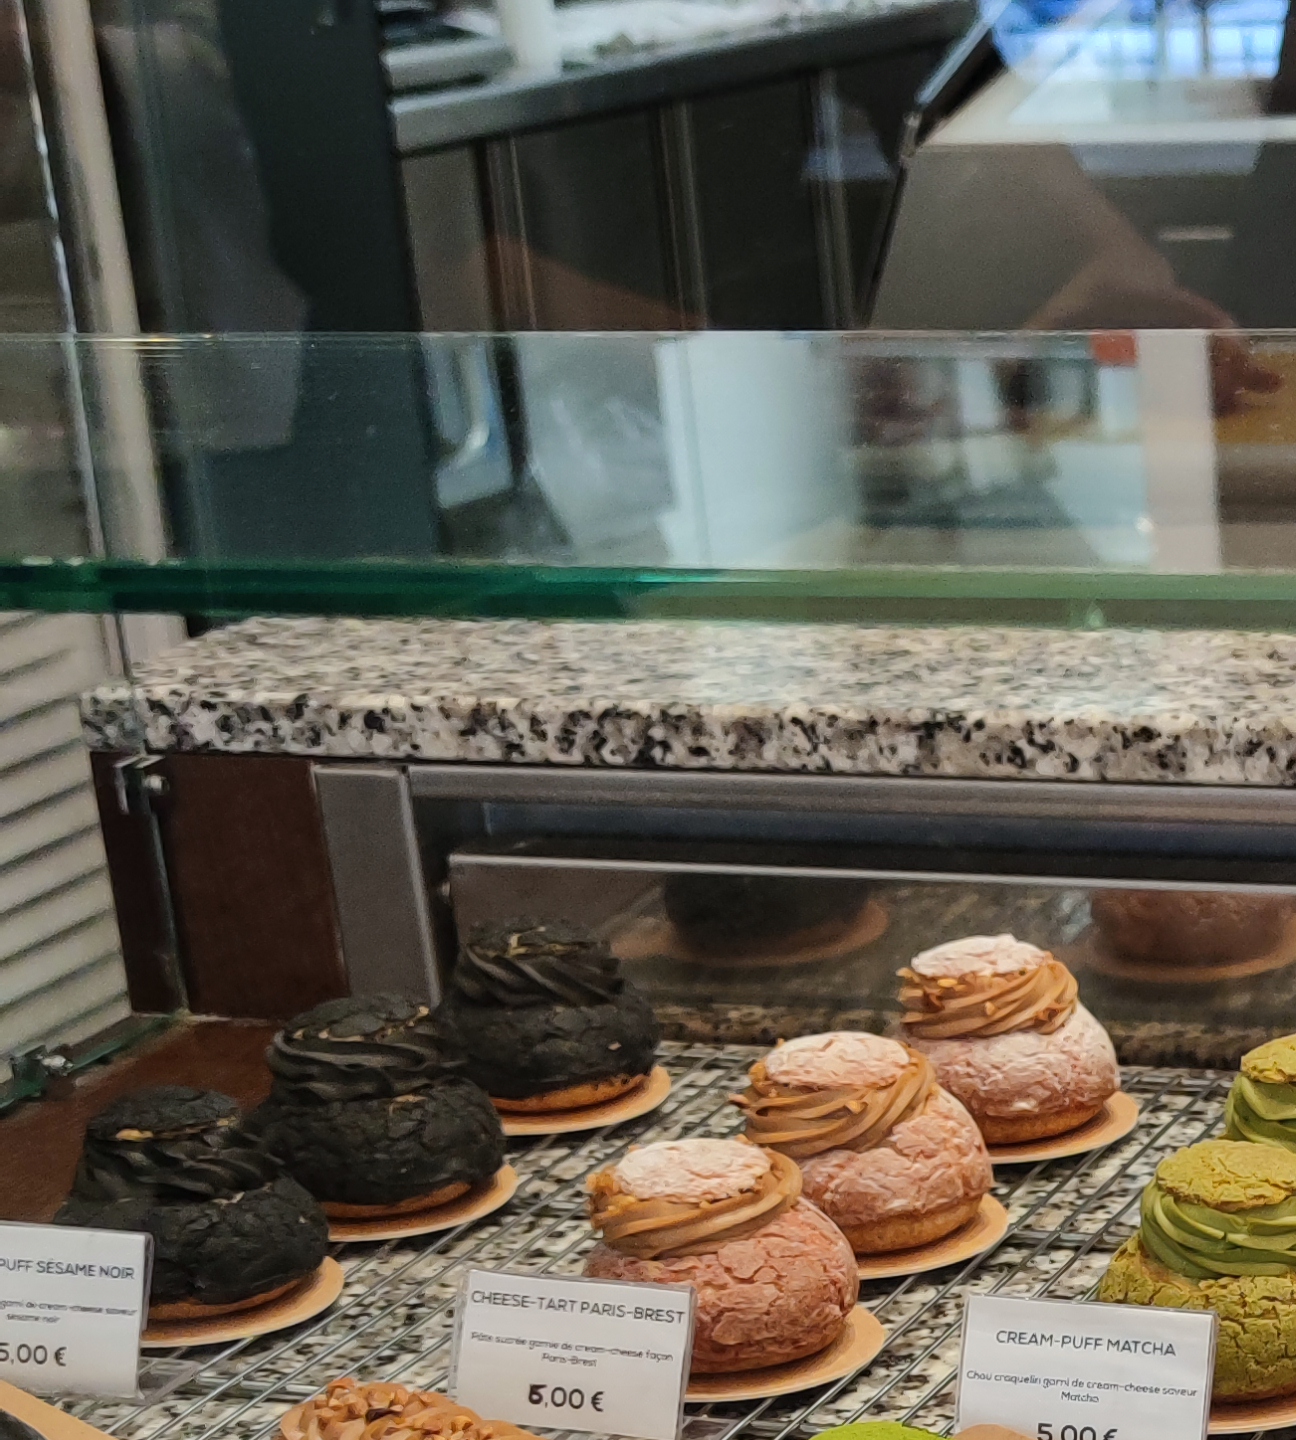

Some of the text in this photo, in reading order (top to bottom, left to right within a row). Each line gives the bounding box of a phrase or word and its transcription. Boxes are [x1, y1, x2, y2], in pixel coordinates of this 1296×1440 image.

[36, 1258, 95, 1276] SÉSAME
[99, 1266, 134, 1279] NOIR
[472, 1291, 684, 1323] CHEESE-TART PARIS-BREST
[0, 1342, 66, 1366] 5,00 €
[996, 1331, 1176, 1356] CREAM-PUFF MATCHA
[646, 1350, 673, 1362] façon
[967, 1370, 1197, 1396] Chou craquelin garni de cream-cheese saveur
[591, 1391, 603, 1412] €
[1061, 1392, 1099, 1402] Matcha
